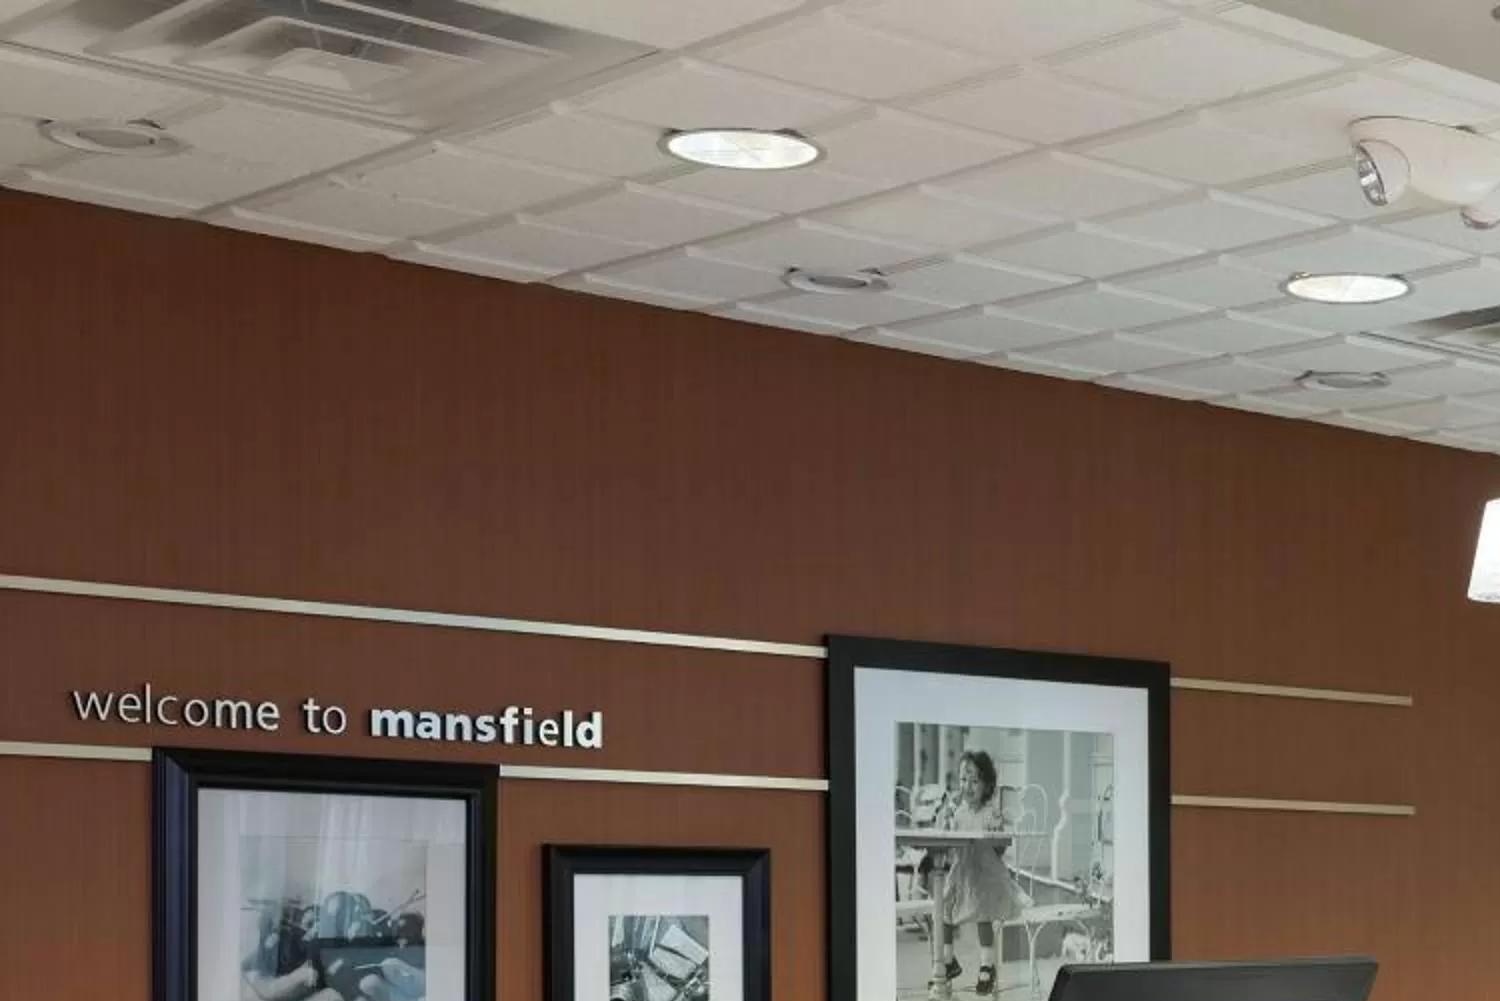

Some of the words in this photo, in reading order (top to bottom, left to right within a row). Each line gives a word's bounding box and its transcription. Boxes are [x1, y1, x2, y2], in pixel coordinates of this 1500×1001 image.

[73, 682, 280, 732] welcome
[303, 697, 347, 735] to
[370, 705, 603, 749] mansfield
